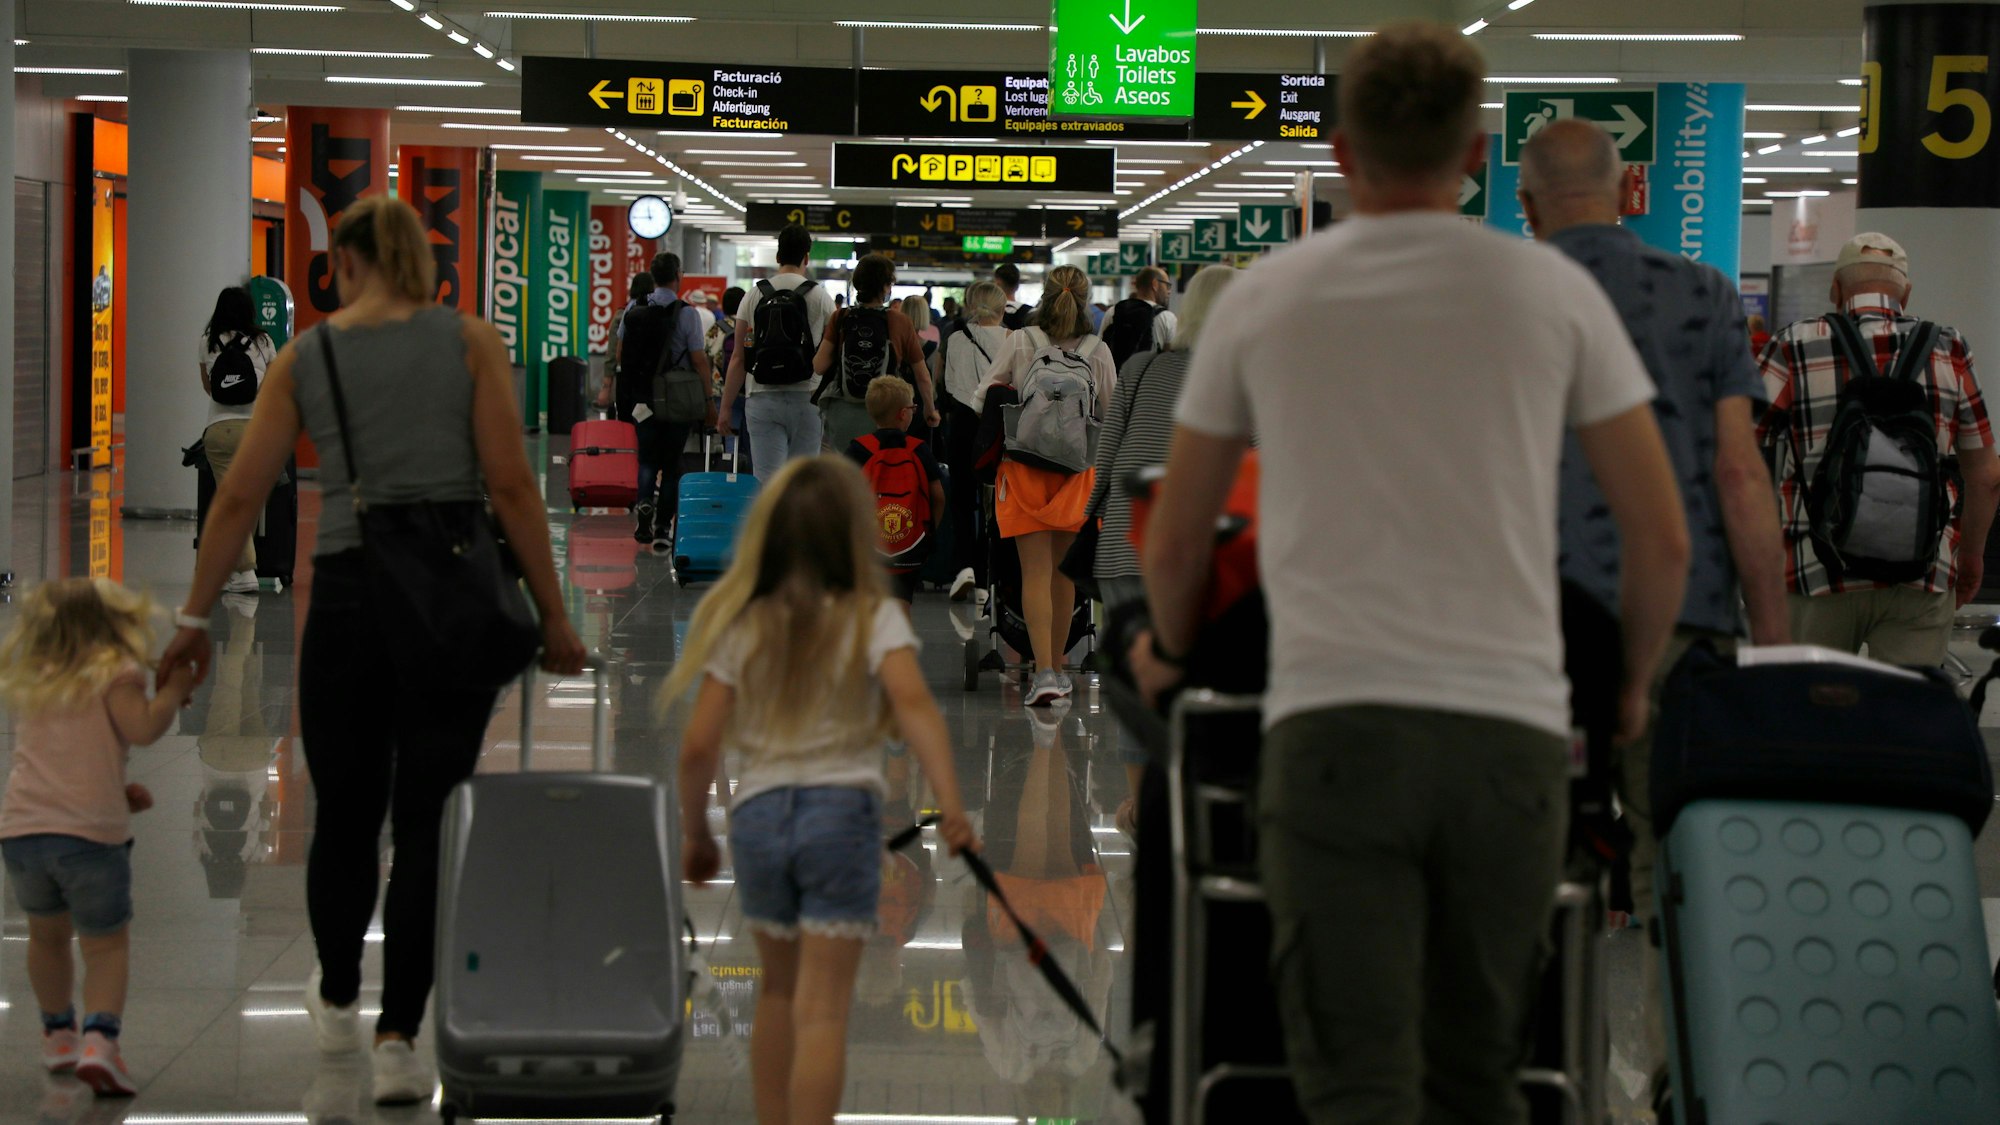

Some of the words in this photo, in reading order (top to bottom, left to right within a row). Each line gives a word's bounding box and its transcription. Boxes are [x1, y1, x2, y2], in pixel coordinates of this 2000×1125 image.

[1115, 45, 1191, 64] Lavabos
[713, 70, 782, 85] Facturació
[1115, 65, 1176, 85] Toilets
[1280, 75, 1325, 88] Sortida
[1005, 76, 1049, 90] Equipat
[713, 85, 758, 99] Check-in
[1005, 91, 1028, 102] Lost
[1114, 87, 1171, 105] Aseos
[1280, 91, 1299, 104] Exit
[712, 100, 771, 116] Abfertigung
[1005, 105, 1049, 116] Verloren
[1921, 55, 1991, 160] 5
[1280, 108, 1321, 123] Ausgang
[712, 116, 789, 131] Facturación
[1005, 119, 1058, 134] Equipajes
[1060, 120, 1125, 133] extraviados
[1280, 124, 1319, 138] Salida
[837, 210, 851, 228] C
[541, 208, 578, 363] Europcar
